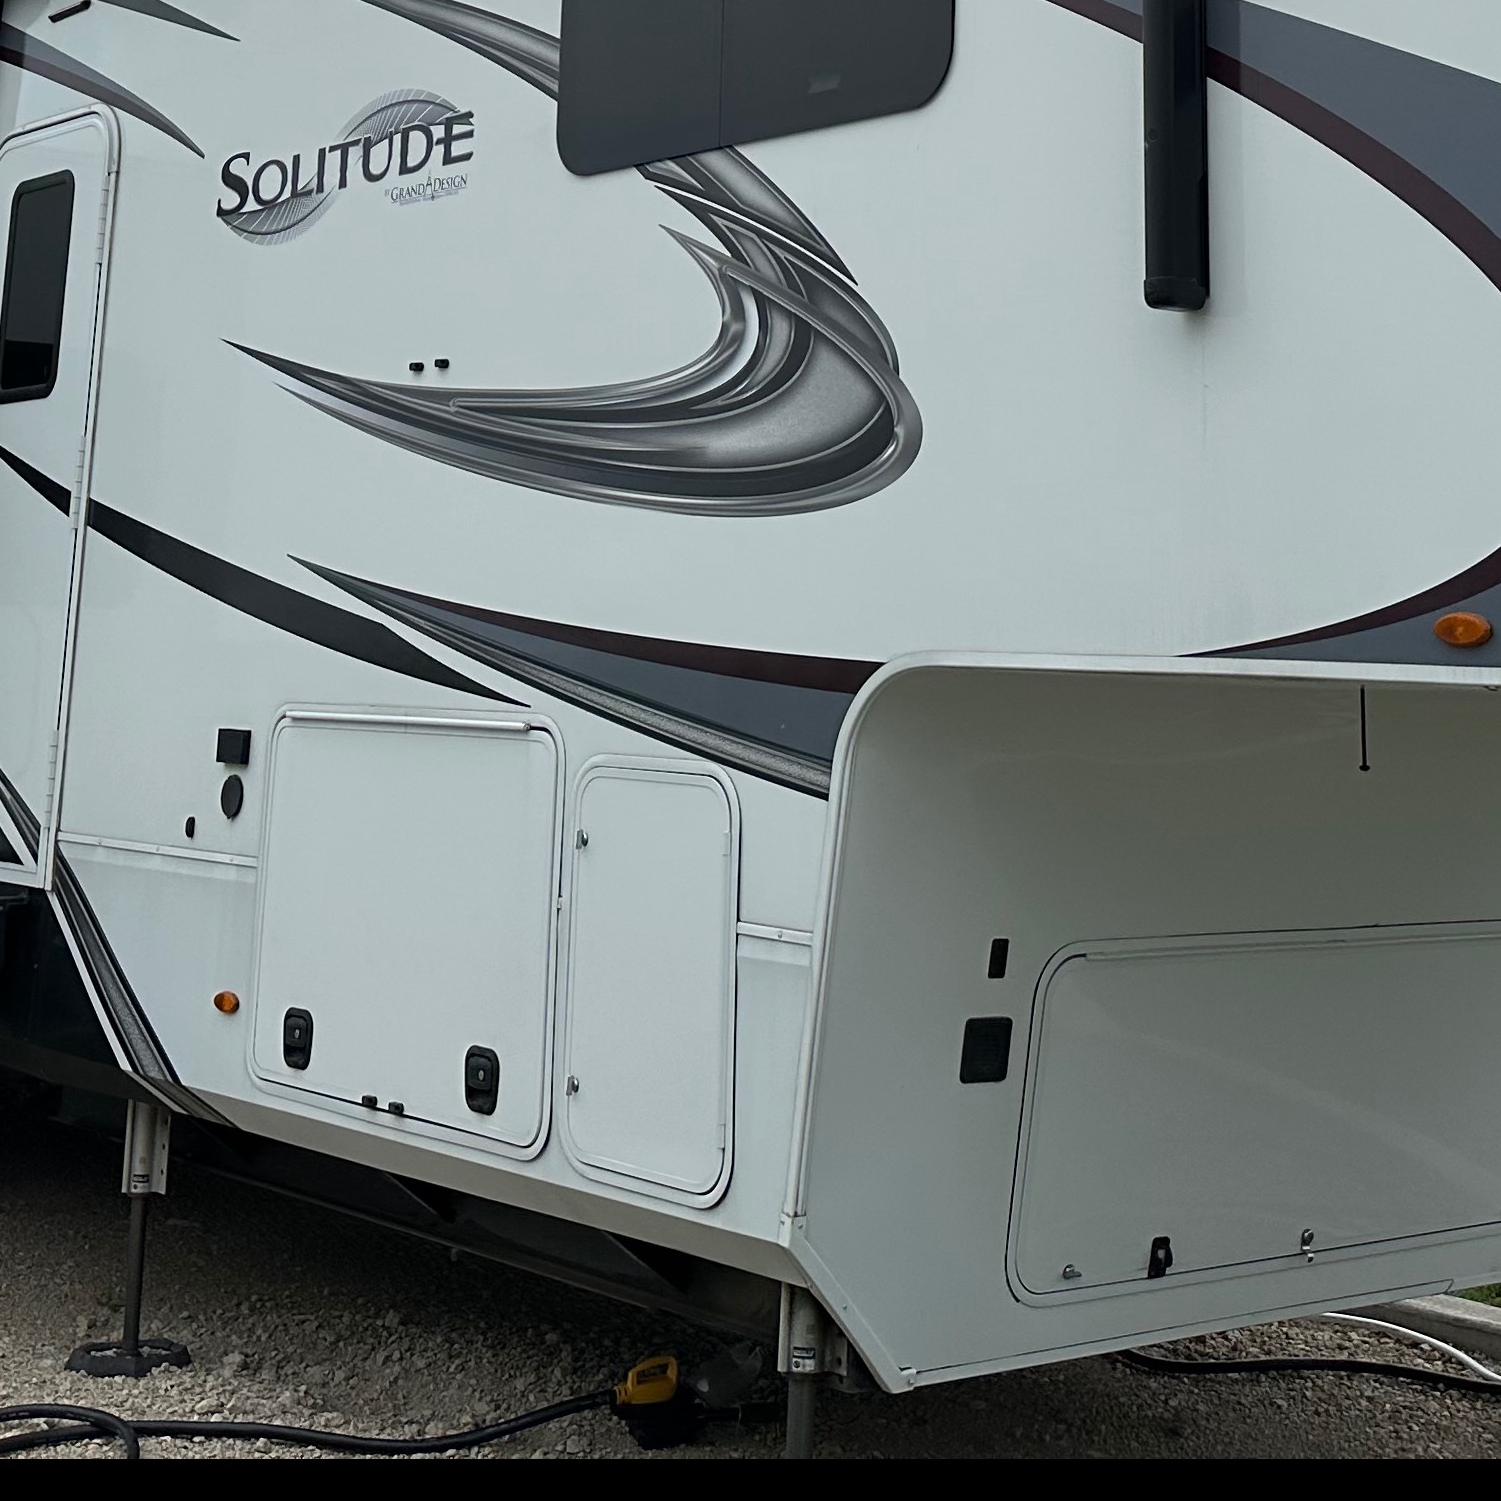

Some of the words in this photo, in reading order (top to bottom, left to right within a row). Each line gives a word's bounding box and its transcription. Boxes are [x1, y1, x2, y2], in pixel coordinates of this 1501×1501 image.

[215, 110, 475, 217] SOLITUDE
[390, 182, 425, 202] GRAND
[433, 172, 468, 192] DESIGN
